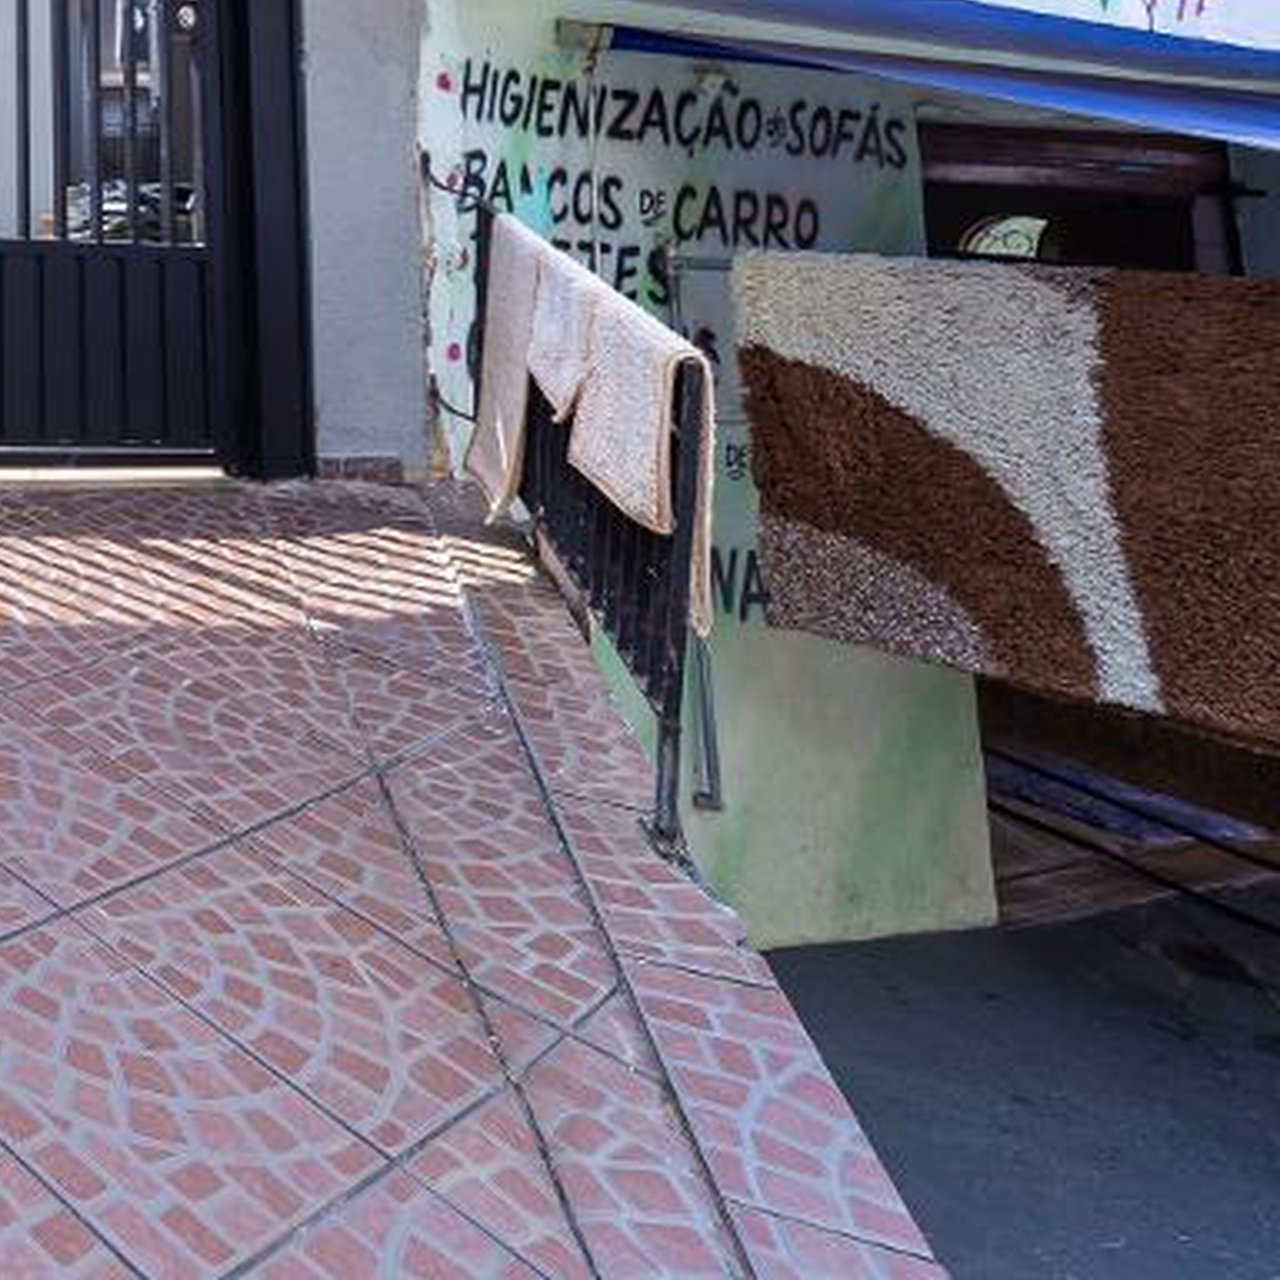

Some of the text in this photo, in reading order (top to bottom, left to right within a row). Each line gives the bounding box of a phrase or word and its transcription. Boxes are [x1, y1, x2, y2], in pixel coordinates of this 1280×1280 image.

[459, 57, 763, 158] HIGIENIZAÇÃO
[785, 98, 908, 169] SOFÁS
[672, 185, 819, 249] CARRO
